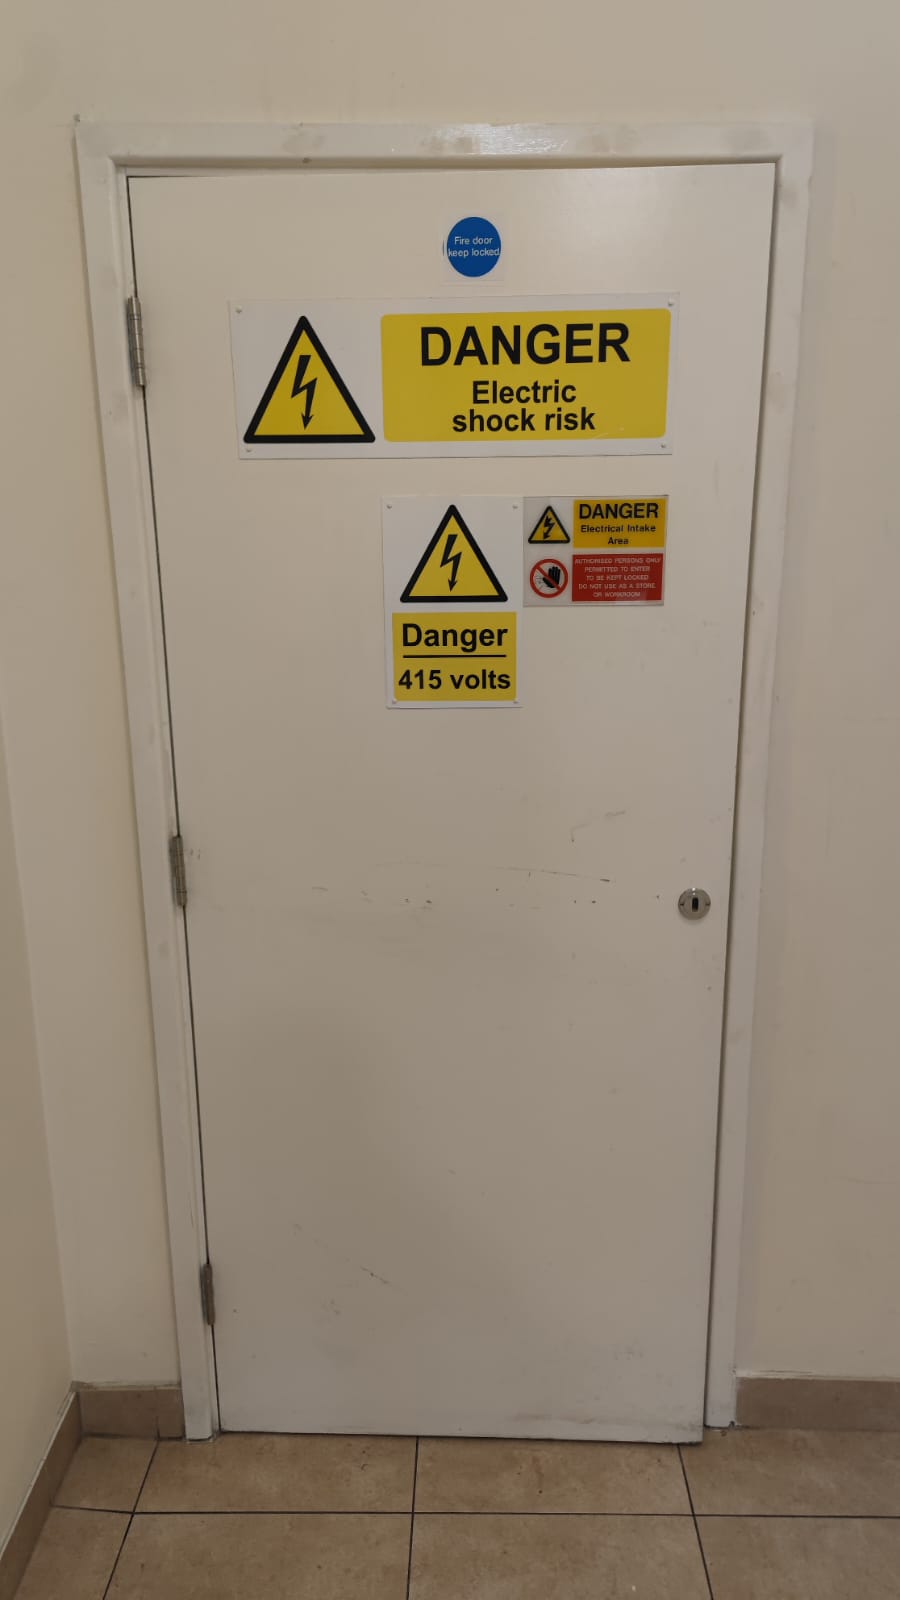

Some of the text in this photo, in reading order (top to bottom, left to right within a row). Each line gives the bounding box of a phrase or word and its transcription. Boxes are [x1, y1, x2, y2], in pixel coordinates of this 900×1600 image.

[454, 236, 493, 245] Fire door
[448, 247, 500, 259] keep locked
[421, 322, 631, 367] DANGER
[472, 379, 577, 405] Electric
[452, 406, 596, 432] shock risk
[579, 502, 659, 519] DANGER
[580, 523, 656, 533] Electrical Intake
[607, 536, 629, 545] Area
[402, 623, 508, 653] Danger
[398, 669, 511, 690] 415 volts
